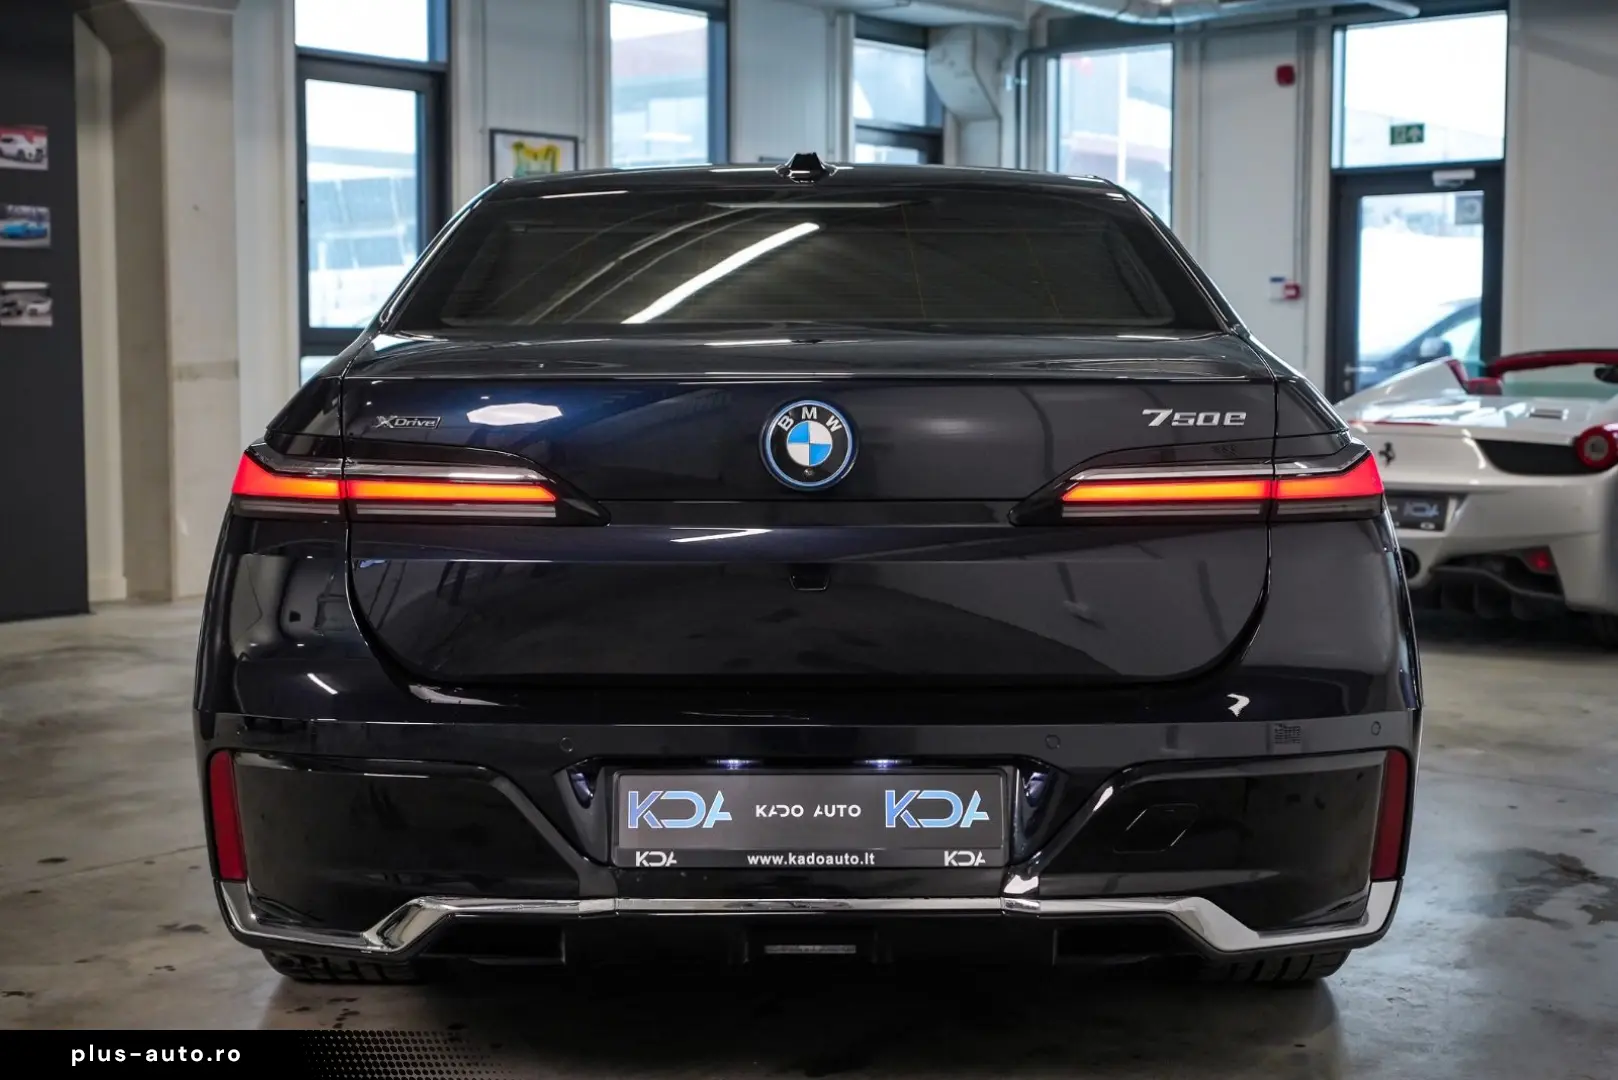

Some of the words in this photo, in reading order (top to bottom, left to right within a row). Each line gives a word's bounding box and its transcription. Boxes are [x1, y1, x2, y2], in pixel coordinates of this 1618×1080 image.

[778, 406, 842, 433] BMW
[1142, 408, 1247, 426] 750e
[628, 790, 733, 829] KDA
[755, 804, 804, 818] KADO
[813, 804, 862, 818] AUTO
[885, 789, 990, 828] KDA
[635, 851, 678, 867] KDA
[747, 852, 876, 866] www.kadoauto.lt
[943, 851, 986, 867] KDA
